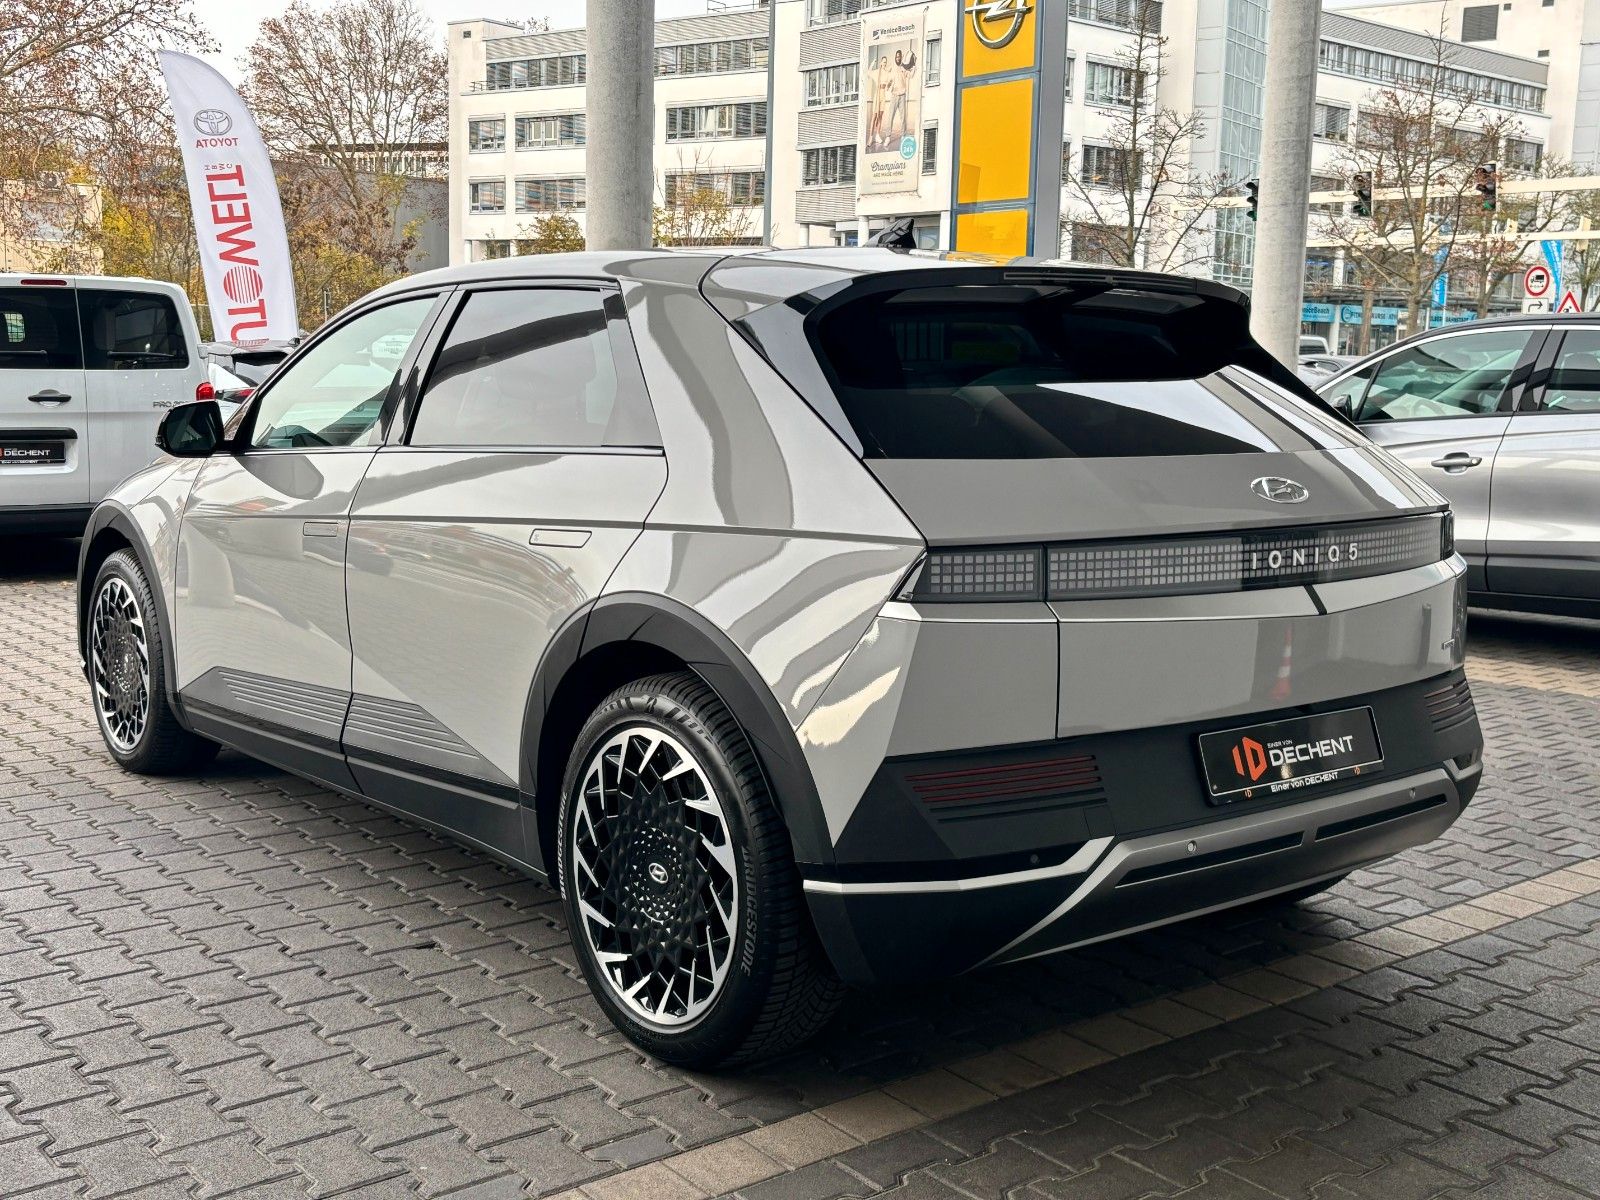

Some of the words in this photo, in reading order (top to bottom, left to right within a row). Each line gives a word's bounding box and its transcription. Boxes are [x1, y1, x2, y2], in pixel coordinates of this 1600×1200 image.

[4, 449, 50, 457] DECHENT
[1269, 735, 1353, 767] DECHENT
[1271, 783, 1289, 793] Einer
[1291, 779, 1304, 789] von
[1305, 771, 1339, 786] DECHENT
[741, 846, 758, 977] BRIDGESTONE
